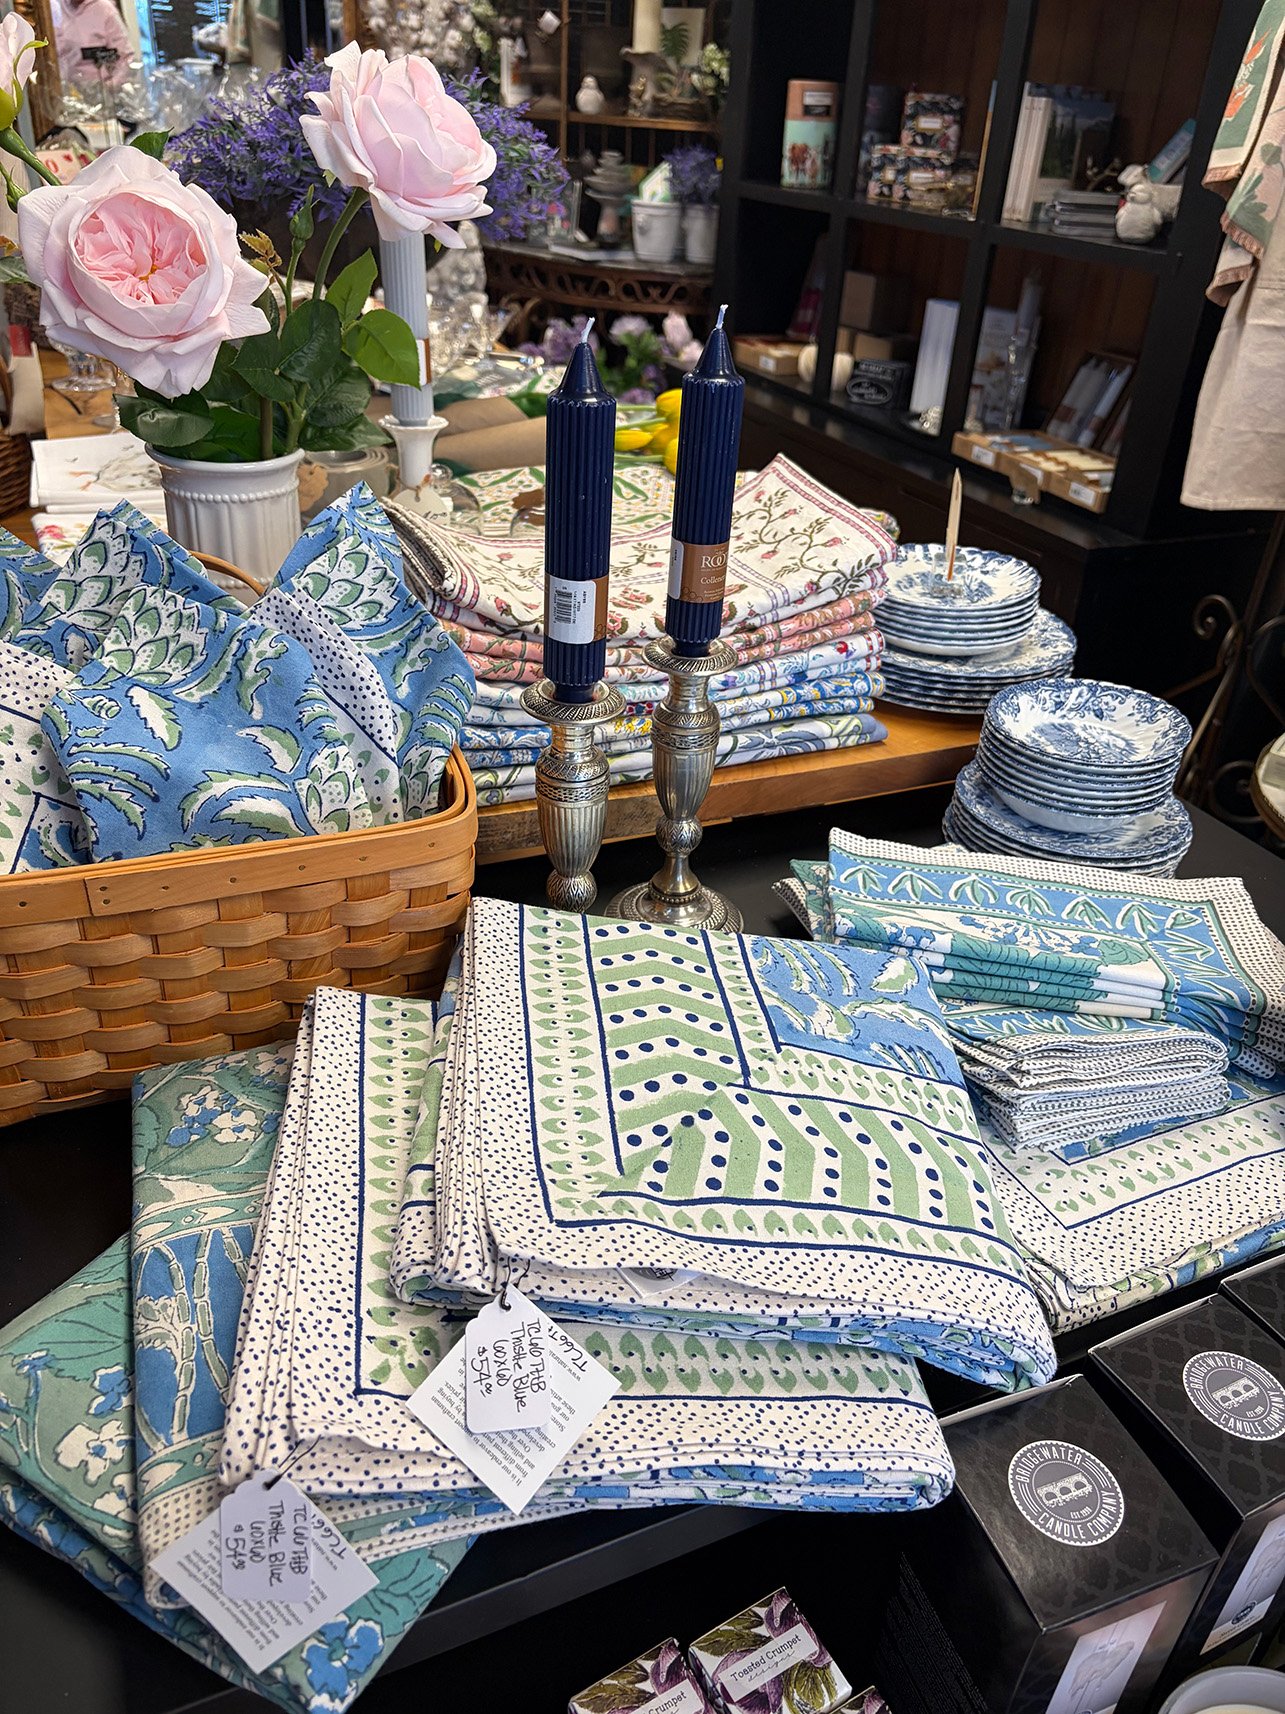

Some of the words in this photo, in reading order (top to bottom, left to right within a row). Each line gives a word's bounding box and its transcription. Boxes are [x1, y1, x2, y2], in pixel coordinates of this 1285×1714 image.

[701, 552, 728, 568] ROO
[1190, 1356, 1243, 1390] BRIDGEWATER
[435, 1386, 456, 1407] buying
[513, 1374, 527, 1413] Blue
[430, 1394, 456, 1420] craftsman
[559, 1410, 570, 1421] our
[560, 1399, 576, 1415] these
[1220, 1413, 1264, 1434] CANDLE
[1263, 1390, 1285, 1431] COMPANY
[515, 1437, 531, 1453] Over
[532, 1425, 557, 1449] creating
[478, 1442, 502, 1466] endeavor
[492, 1441, 516, 1465] different
[506, 1440, 526, 1460] selling
[501, 1464, 512, 1474] our
[513, 1462, 528, 1477] from
[523, 1458, 535, 1470] and
[1016, 1446, 1082, 1483] BRIDGEWATER
[1038, 1512, 1085, 1539] CANDLE
[1087, 1490, 1117, 1536] COMPANY
[269, 1553, 286, 1587] Blue
[730, 1658, 766, 1682] Toasted
[766, 1634, 802, 1661] Crumpet
[648, 1690, 688, 1714] Crumpet
